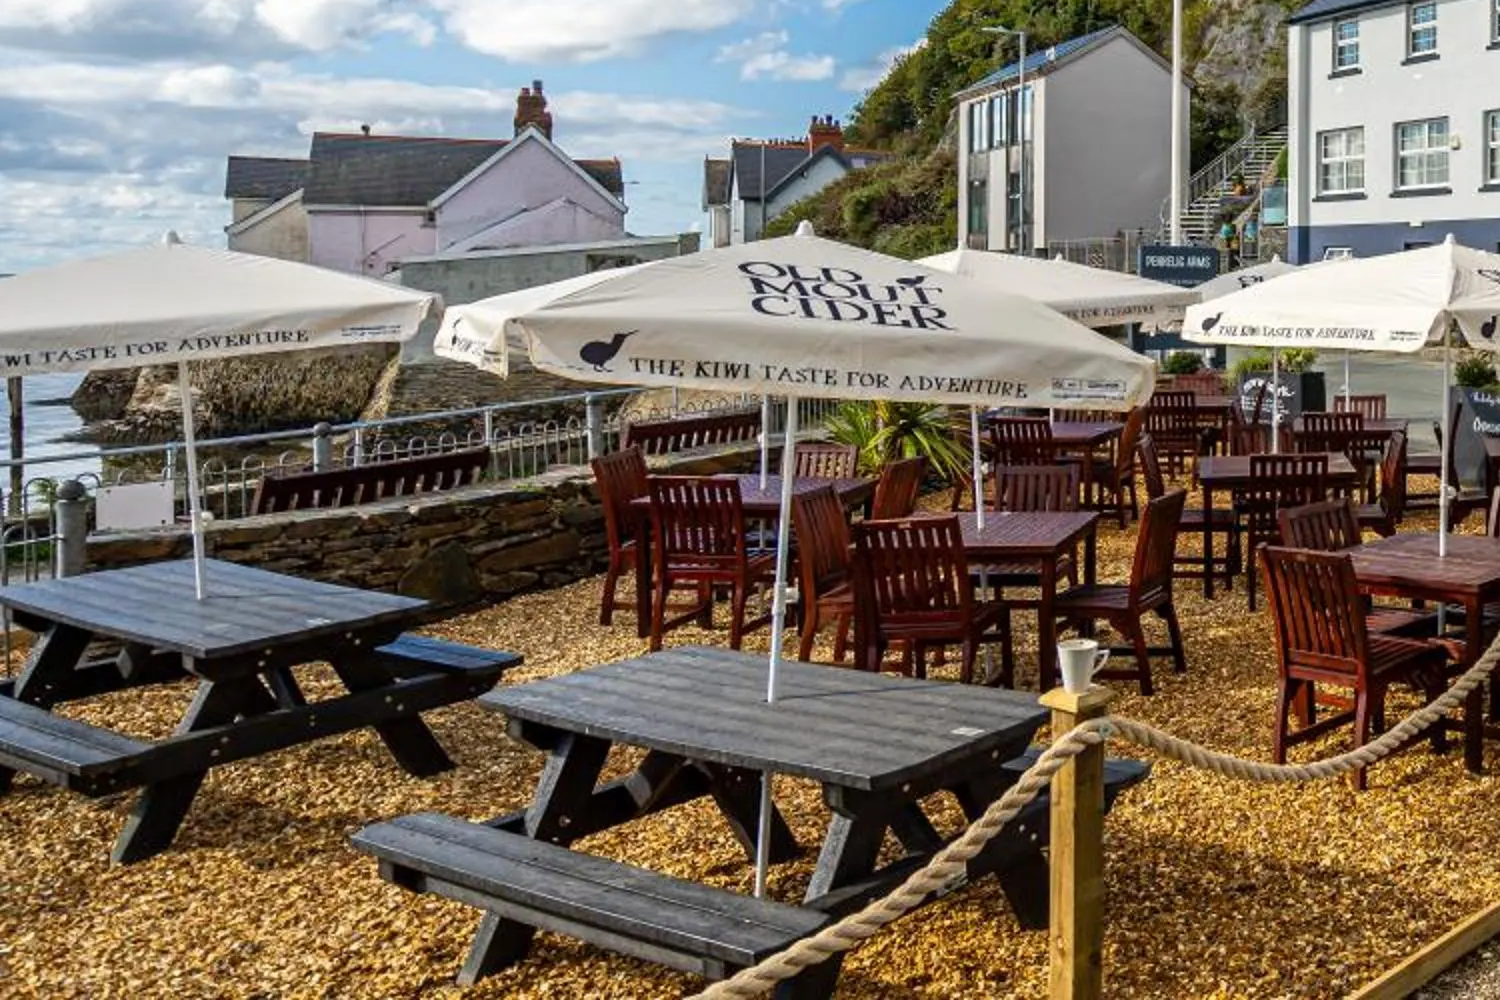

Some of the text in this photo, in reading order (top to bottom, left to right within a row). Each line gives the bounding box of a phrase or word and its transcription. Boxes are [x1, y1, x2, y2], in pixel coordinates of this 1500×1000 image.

[738, 261, 862, 283] OLD
[749, 277, 943, 306] MOUT
[751, 296, 957, 331] CIDER
[39, 345, 117, 364] TASTE
[126, 340, 169, 356] FOR
[178, 330, 310, 352] ADVENTURE
[629, 356, 685, 377] THE
[695, 360, 751, 379] KIWI
[760, 364, 838, 387] TASTE
[847, 371, 889, 389] FOR
[900, 375, 1029, 399] ADVENTURE
